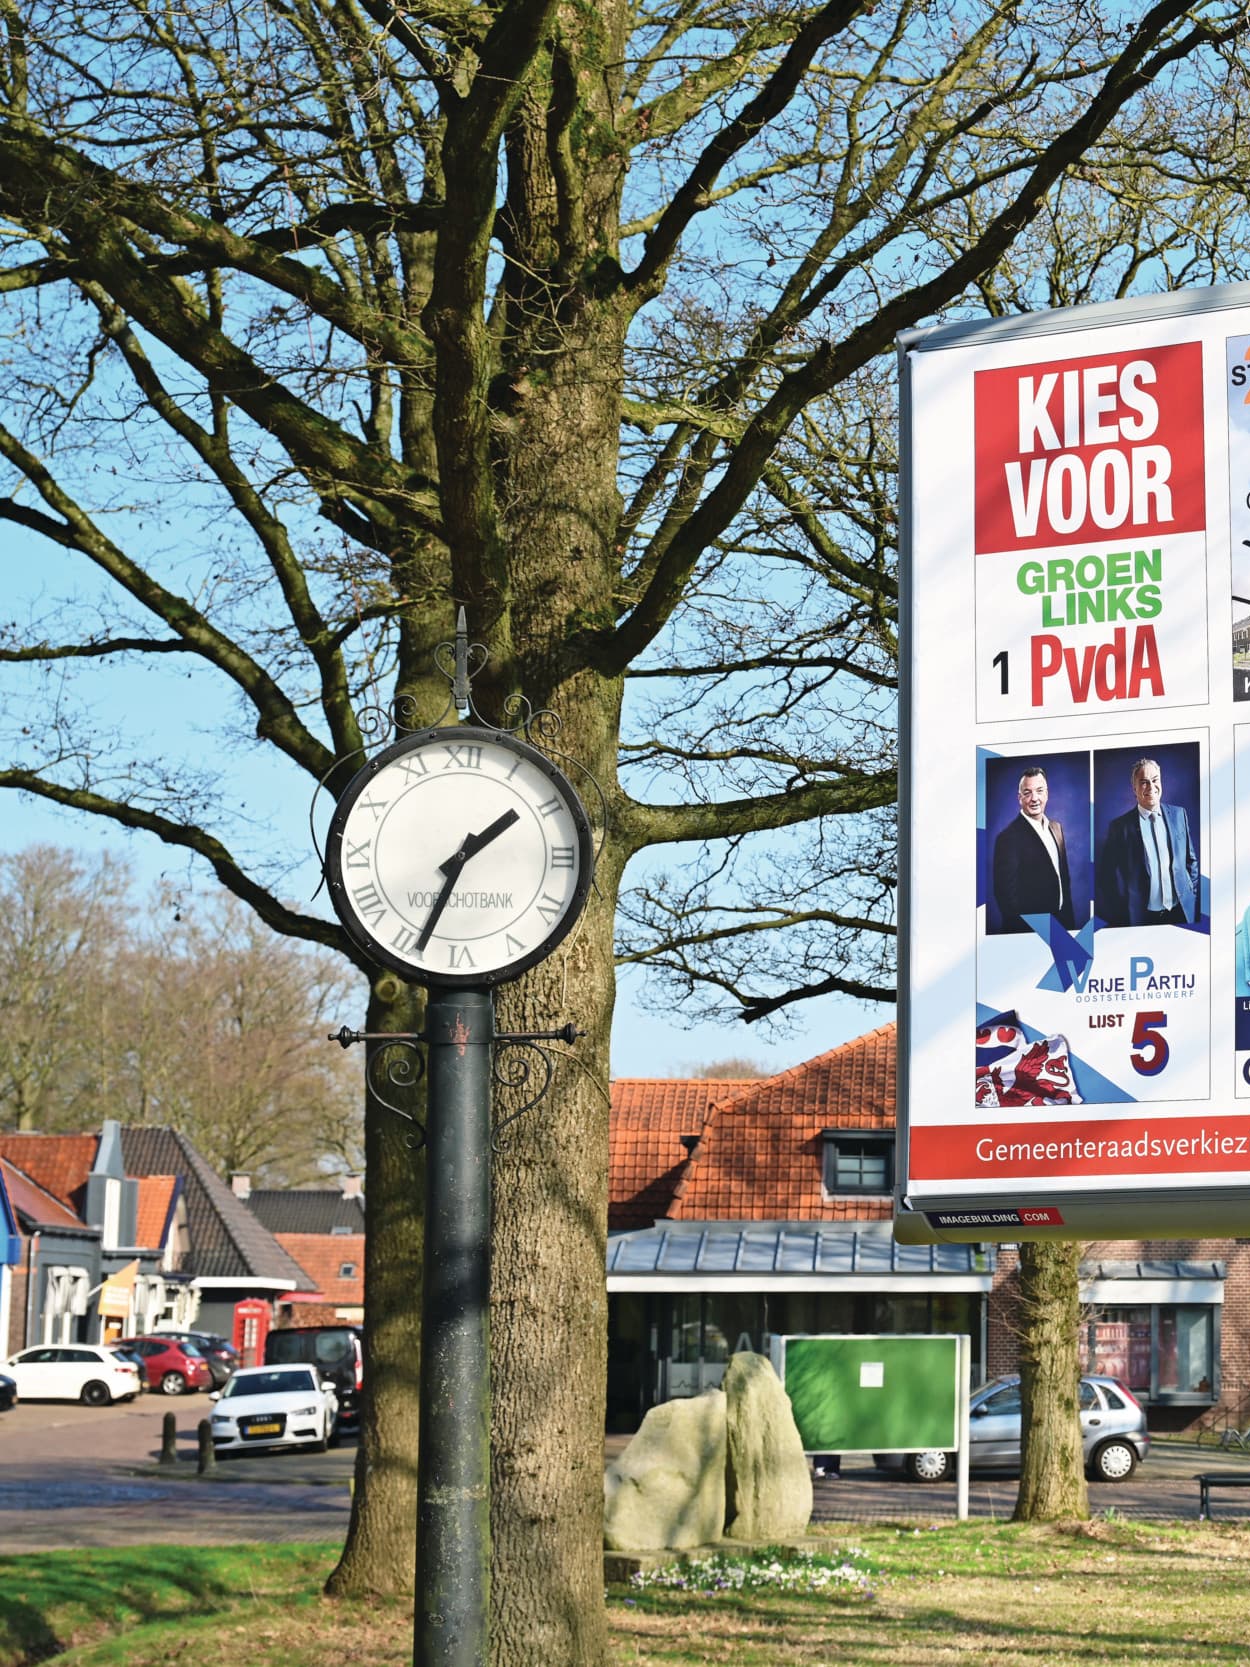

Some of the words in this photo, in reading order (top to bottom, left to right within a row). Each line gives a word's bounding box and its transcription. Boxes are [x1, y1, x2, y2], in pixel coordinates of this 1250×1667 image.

[1018, 360, 1159, 454] KIES
[1004, 444, 1175, 538] VOOR
[1016, 548, 1162, 596] GROEN
[1042, 584, 1163, 628] LINKS
[992, 650, 1009, 695] 1
[1031, 624, 1165, 707] PvdA
[398, 753, 430, 785] XI
[442, 745, 483, 770] XII
[357, 791, 389, 821] X
[536, 795, 564, 819] II
[551, 845, 575, 870] III
[352, 880, 388, 930] VIII
[408, 891, 513, 908] VOORCHOTBANK
[505, 932, 528, 957] V
[1066, 959, 1125, 994] VRIJE
[1130, 957, 1195, 991] PARTIJ
[1076, 991, 1195, 1003] OOSTSTELLINGWERF
[1089, 1014, 1125, 1028] LIJST
[1130, 1011, 1170, 1077] 5
